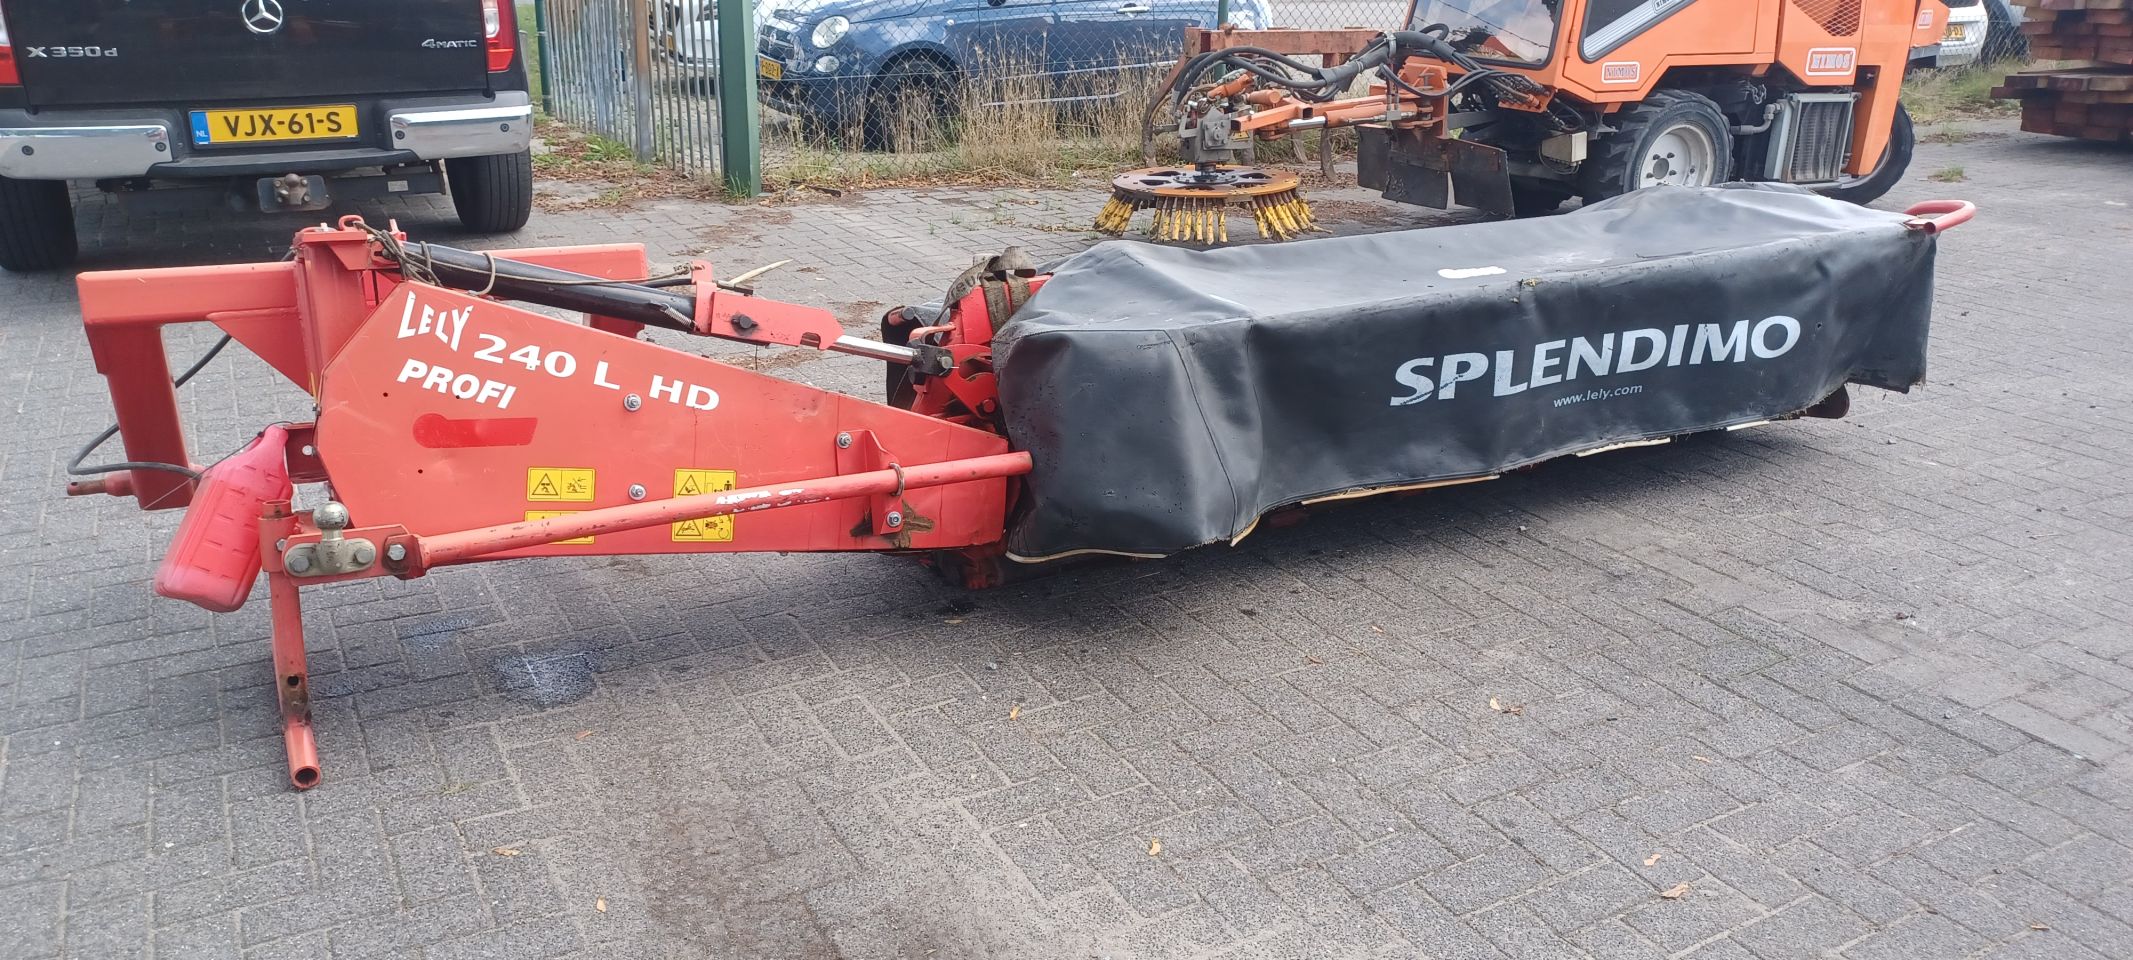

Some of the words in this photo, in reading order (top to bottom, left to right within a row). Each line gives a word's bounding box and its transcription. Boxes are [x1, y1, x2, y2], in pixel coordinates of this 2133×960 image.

[421, 38, 477, 49] 4MATIC
[223, 111, 342, 138] VJX-61-S
[397, 290, 474, 352] LELY
[473, 333, 577, 379] 240
[594, 360, 621, 391] L
[648, 374, 720, 411] HD
[1390, 315, 1801, 407] SPLENDIMO
[397, 358, 517, 410] PROFI
[1553, 384, 1643, 408] www.lely.com
